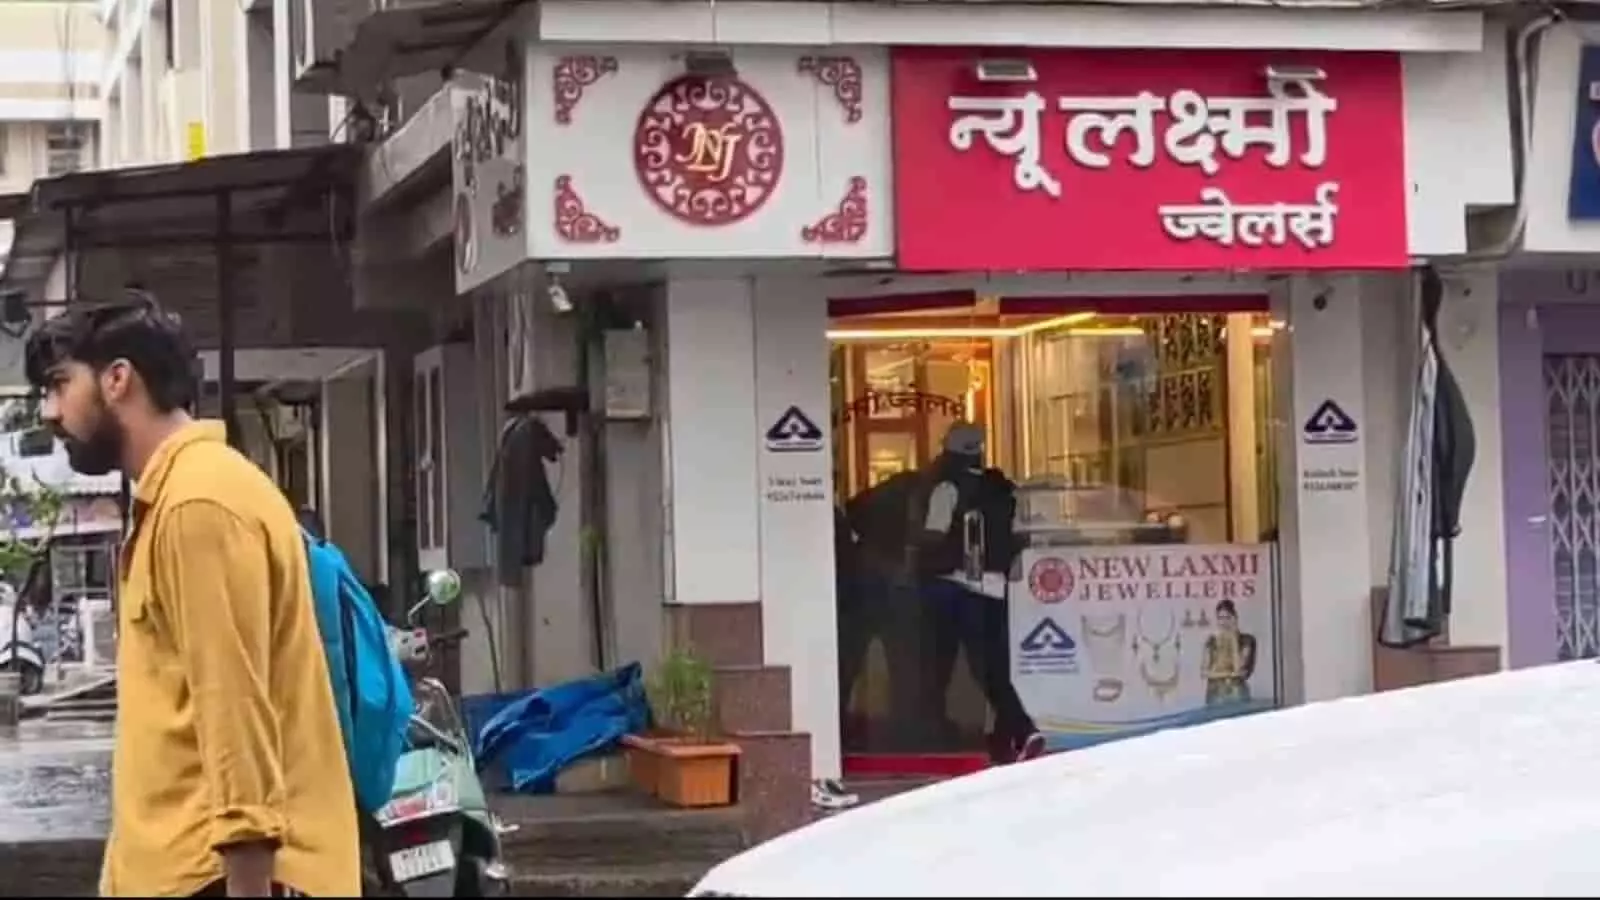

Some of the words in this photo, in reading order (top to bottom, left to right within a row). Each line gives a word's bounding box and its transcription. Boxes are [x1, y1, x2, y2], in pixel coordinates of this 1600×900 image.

[948, 91, 1061, 197] न्यू
[1059, 78, 1337, 175] लक्ष्मी
[1159, 183, 1339, 247] ज्वेलर्स
[1079, 554, 1151, 579] NEW
[1161, 553, 1259, 578] LAXMI
[1079, 580, 1256, 601] JEWELLERS
